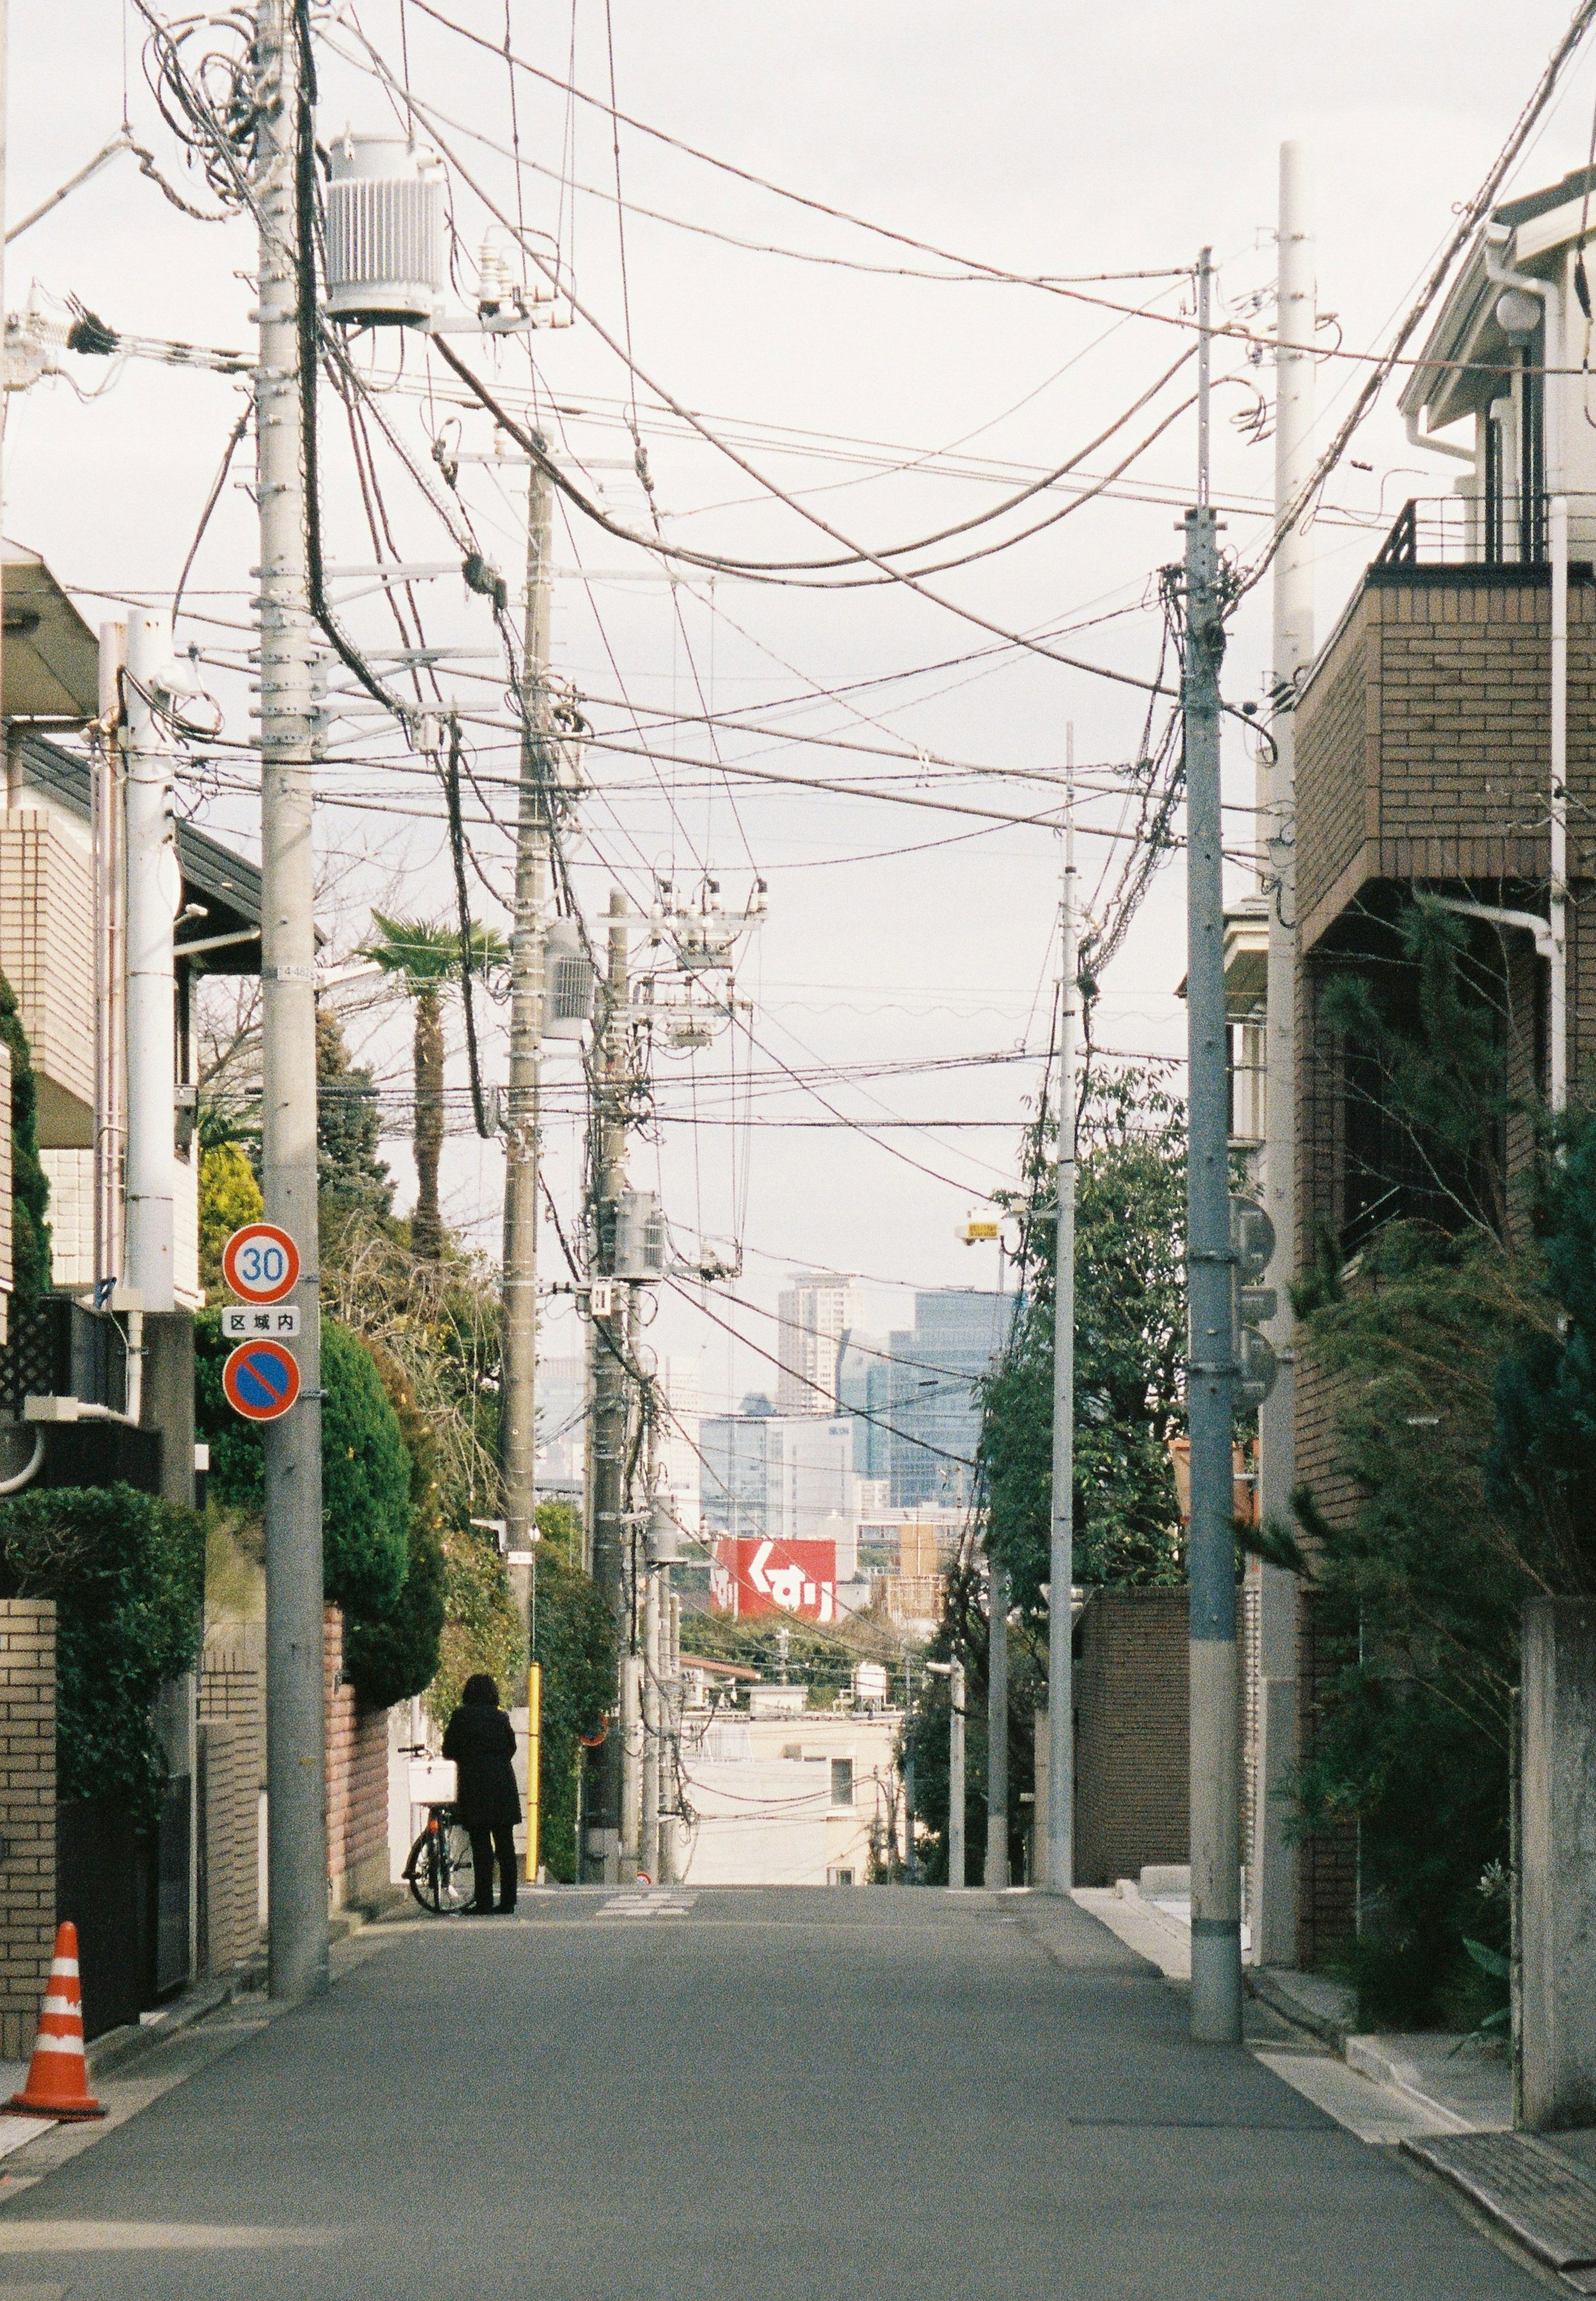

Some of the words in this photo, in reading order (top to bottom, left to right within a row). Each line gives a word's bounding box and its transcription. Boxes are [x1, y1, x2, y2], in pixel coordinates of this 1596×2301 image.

[243, 1248, 283, 1281] 30
[231, 1313, 293, 1330] 区域内
[748, 1540, 832, 1622] くすり
